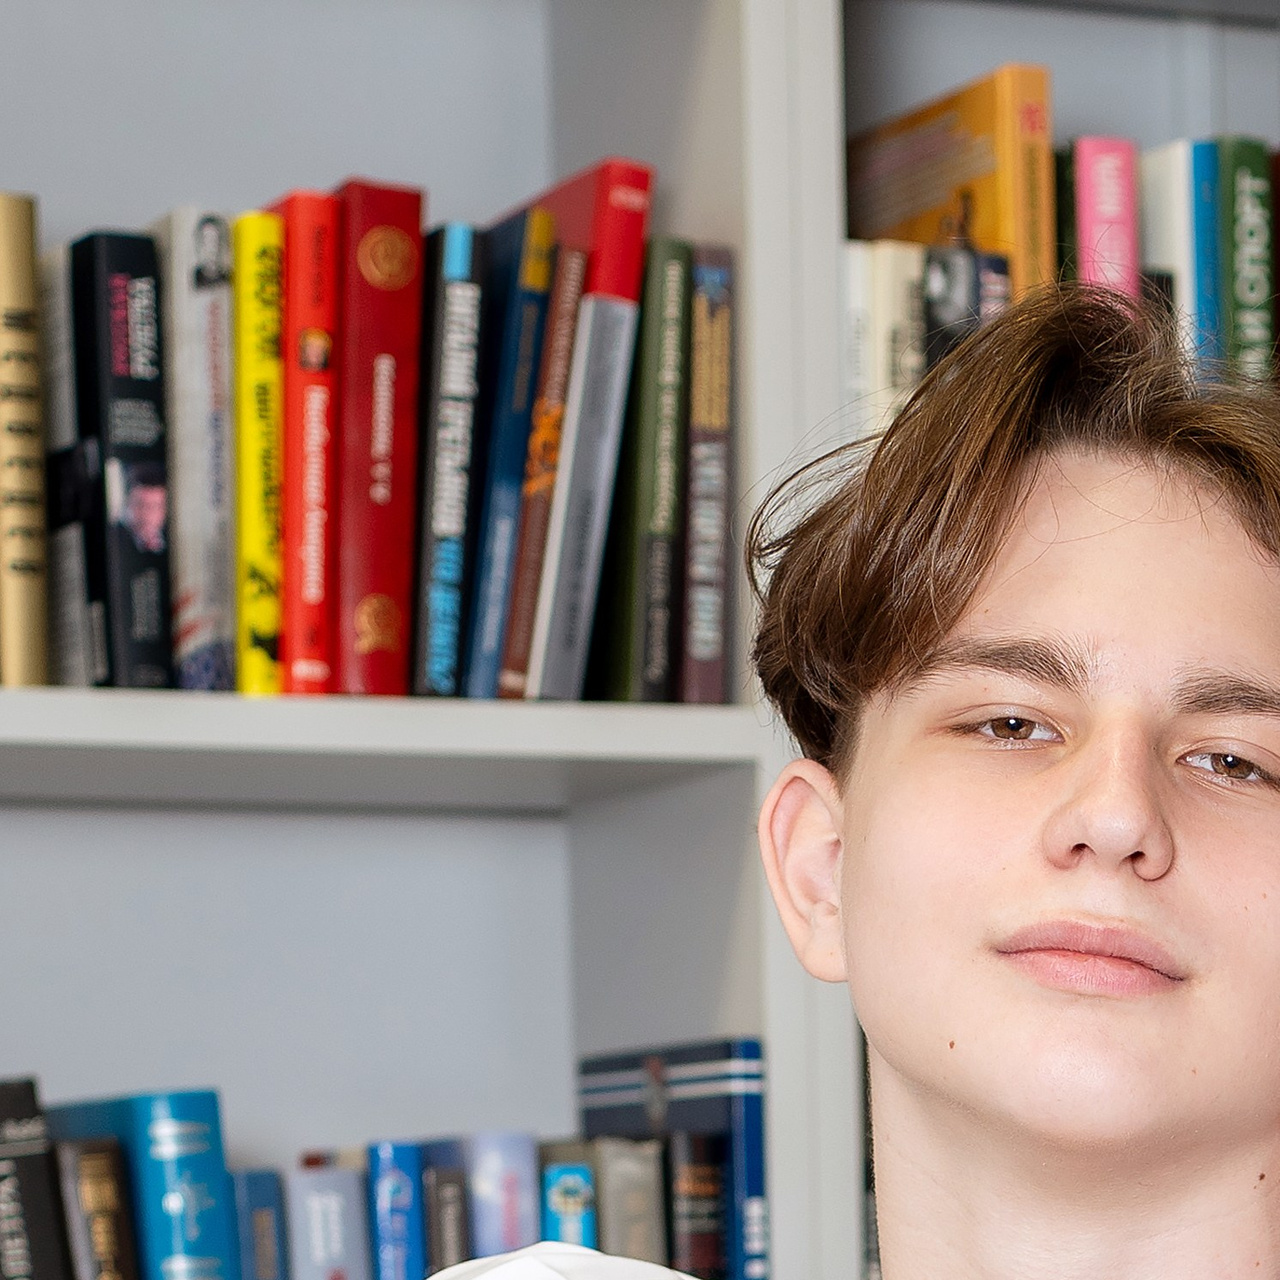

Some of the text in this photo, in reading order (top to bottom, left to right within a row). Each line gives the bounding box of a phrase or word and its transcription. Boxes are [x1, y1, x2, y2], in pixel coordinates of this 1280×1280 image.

[1233, 167, 1271, 305] СПОРТ
[438, 282, 482, 396] ВИТАЛИЙ
[431, 399, 473, 536] ТРЕТЬЯКОВ
